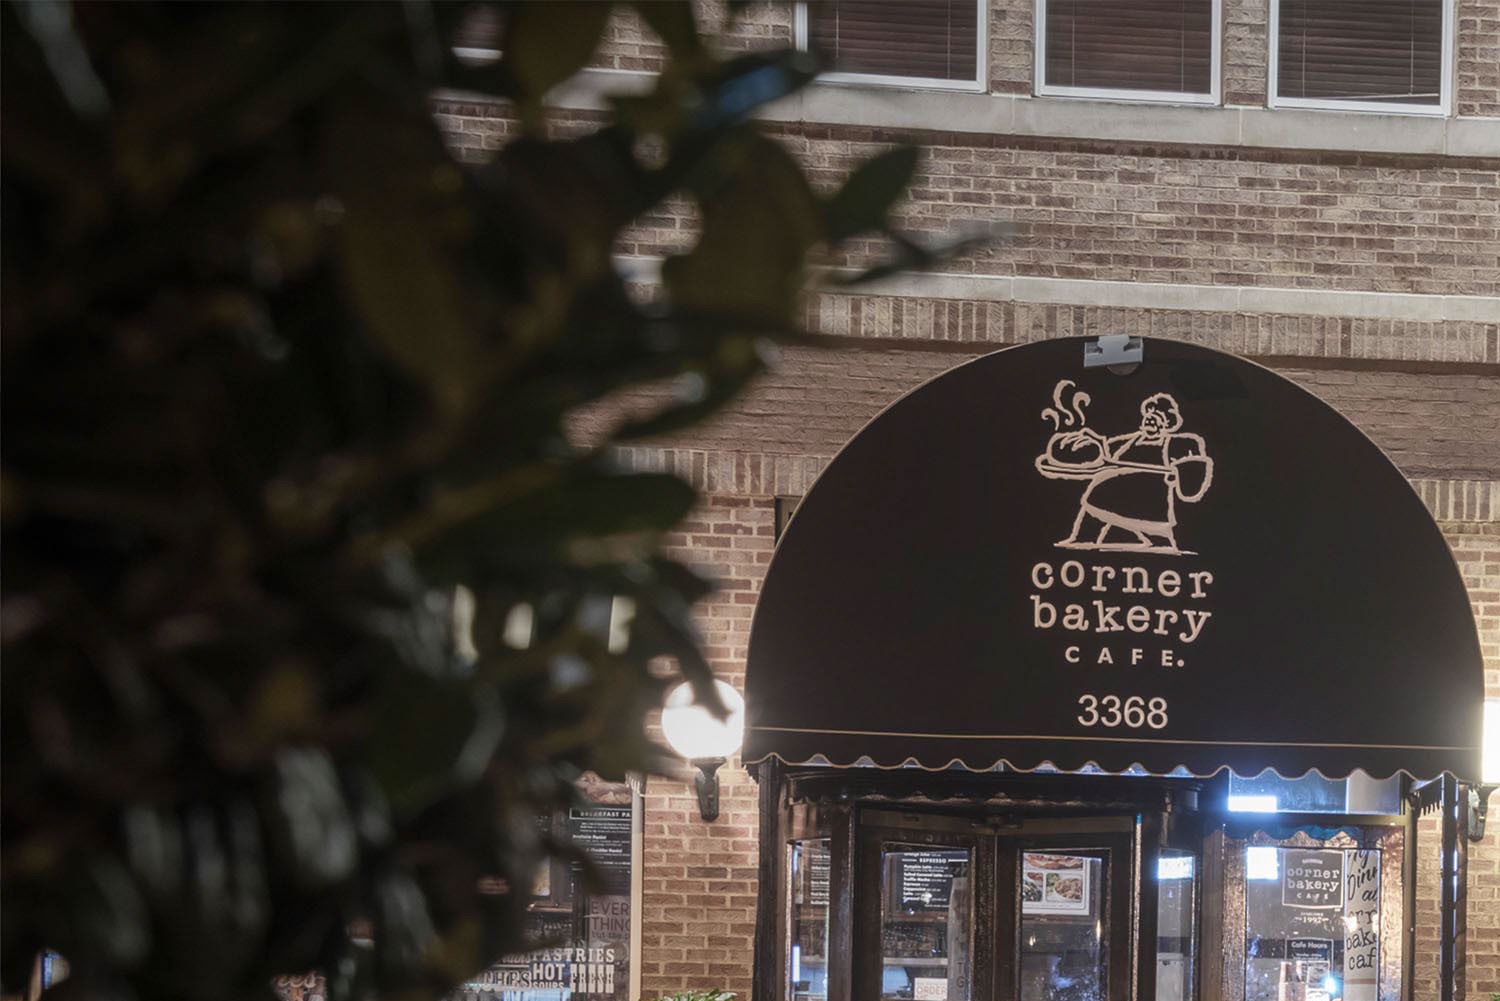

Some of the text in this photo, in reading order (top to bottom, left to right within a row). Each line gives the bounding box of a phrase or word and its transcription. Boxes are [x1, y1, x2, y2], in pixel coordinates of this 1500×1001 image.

[1031, 560, 1214, 599] corner
[1030, 595, 1212, 643] bakery
[1077, 694, 1168, 728] 3368
[1287, 867, 1340, 879] corner
[1287, 878, 1340, 892] bakery
[1296, 892, 1329, 900] CAFE
[532, 948, 615, 963] PASTRIES
[532, 963, 566, 981] HOT
[570, 964, 615, 994] FRESH
